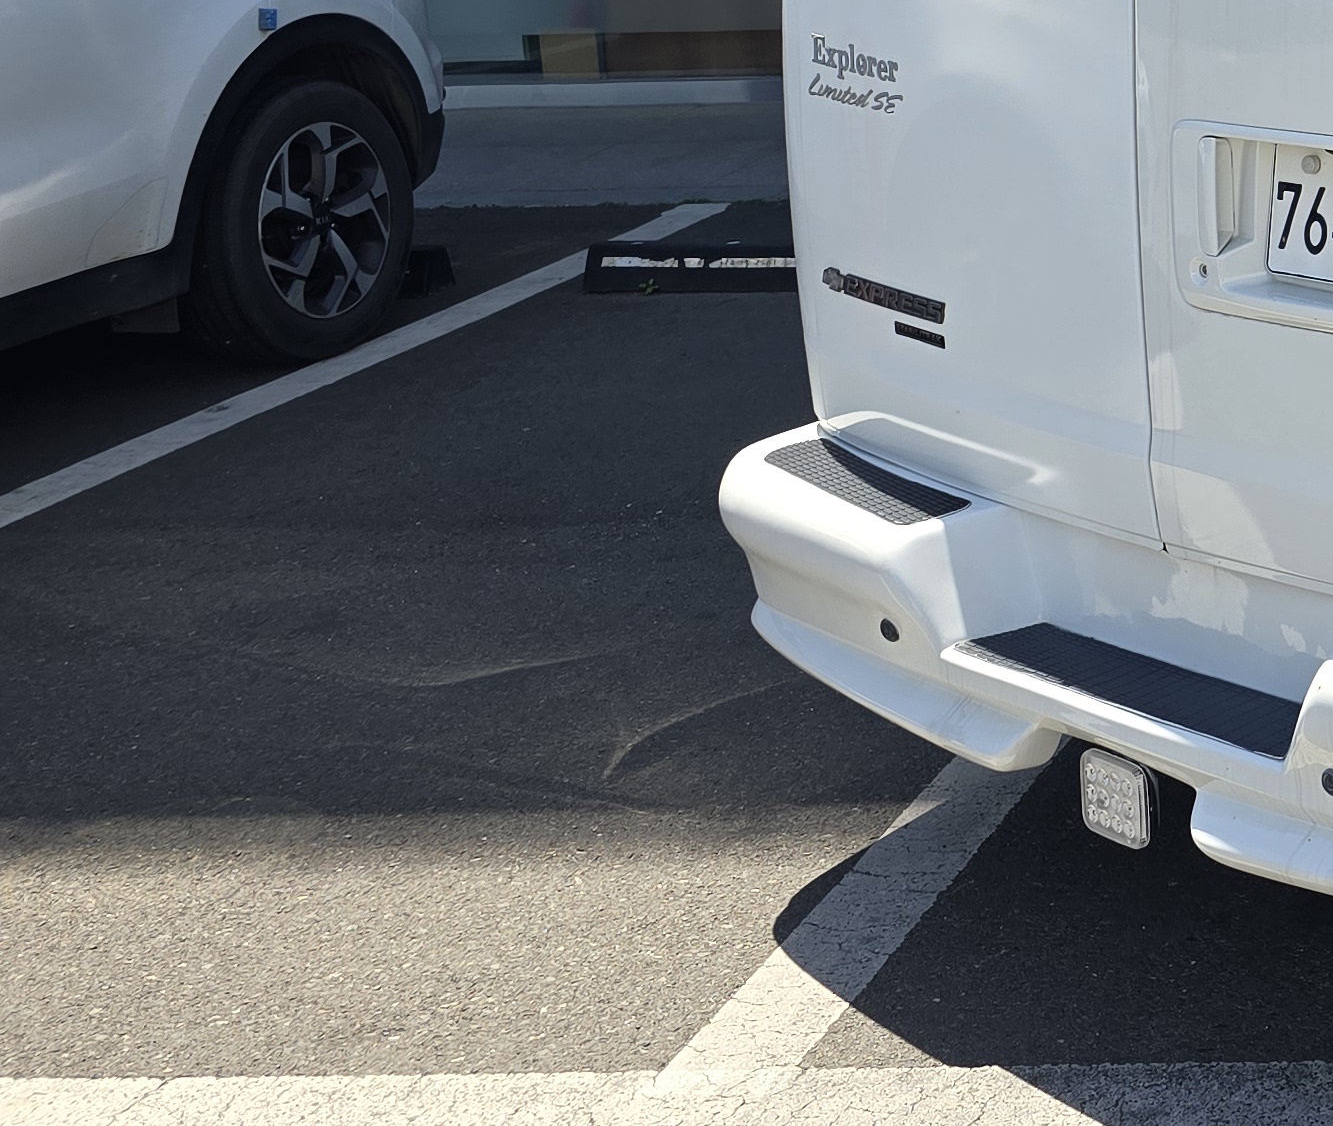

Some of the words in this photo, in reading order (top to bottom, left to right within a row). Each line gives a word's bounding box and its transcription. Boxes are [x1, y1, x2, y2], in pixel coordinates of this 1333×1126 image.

[810, 33, 899, 83] Explorer
[808, 72, 872, 109] Limited
[872, 91, 904, 115] SE
[844, 275, 944, 324] EXPRESS
